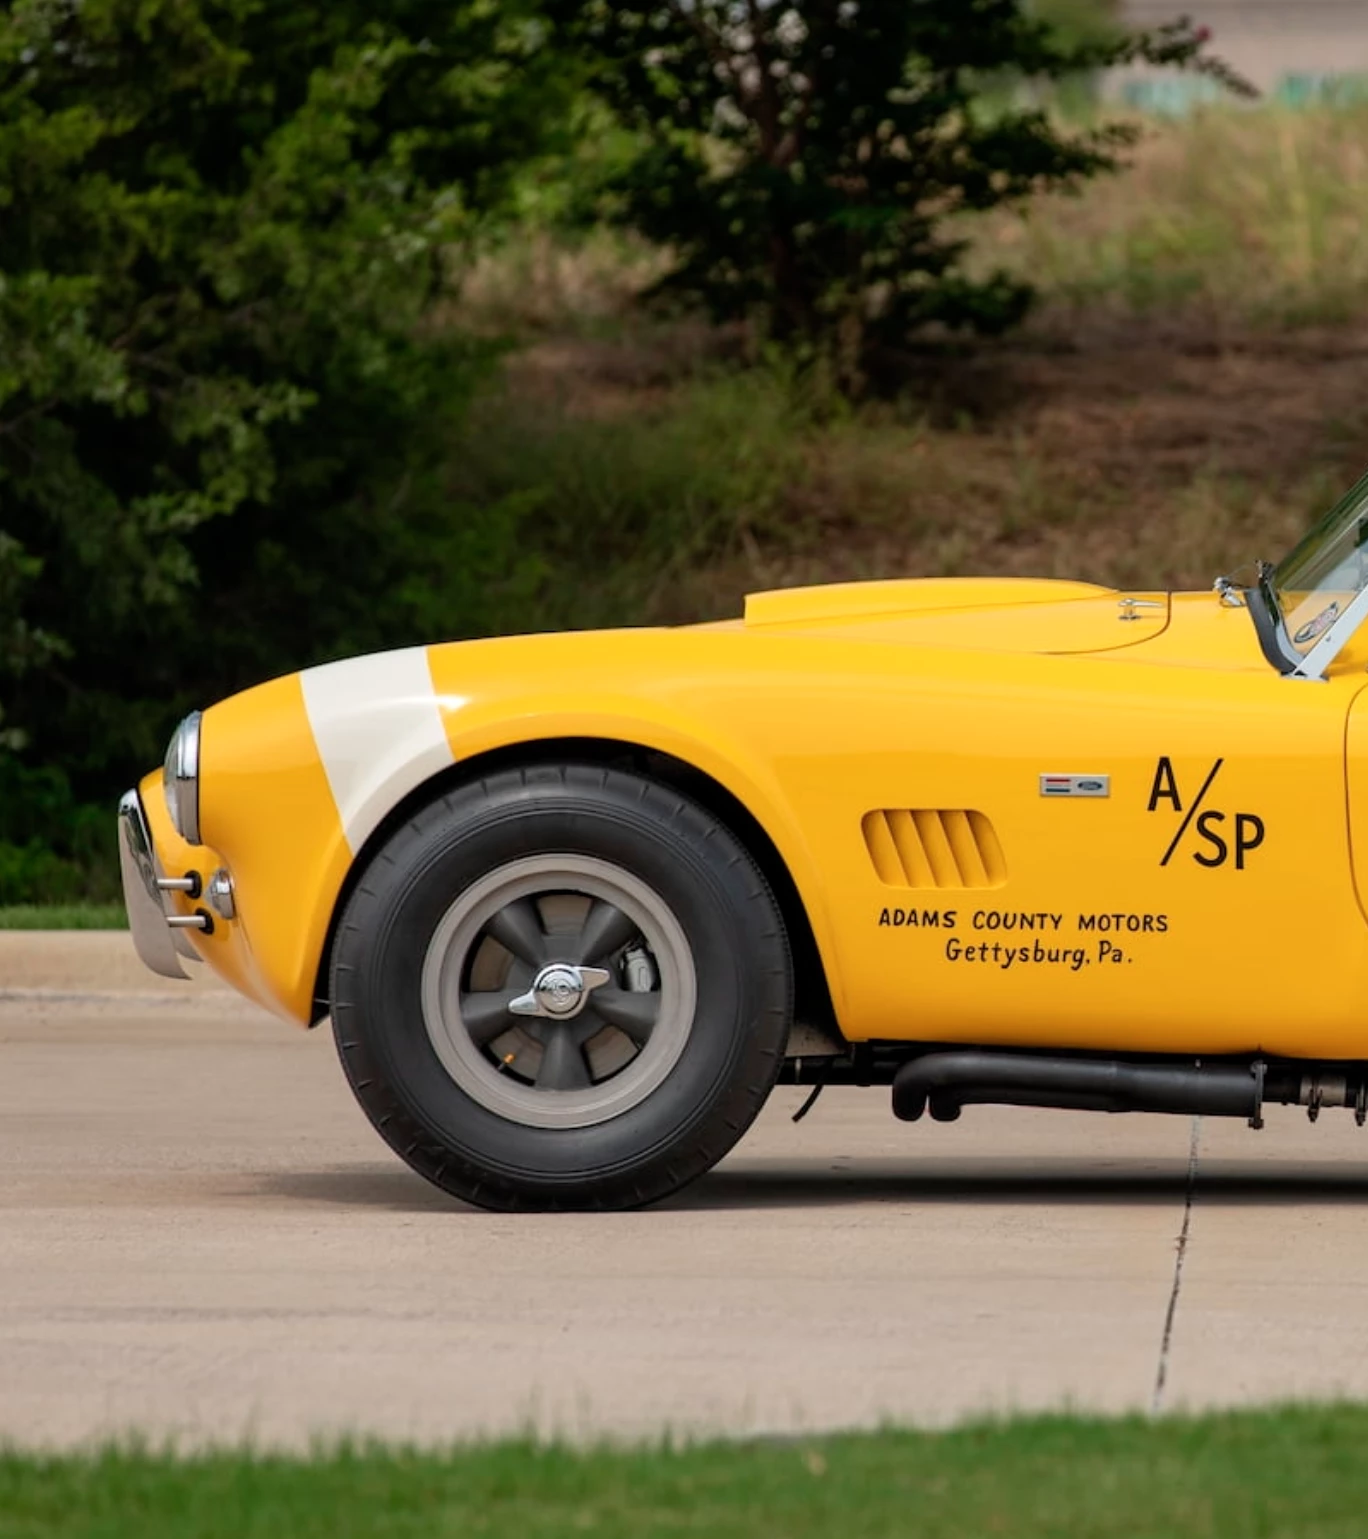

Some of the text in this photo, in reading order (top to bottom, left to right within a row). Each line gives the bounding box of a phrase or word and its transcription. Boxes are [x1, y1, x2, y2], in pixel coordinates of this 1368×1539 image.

[878, 907, 1169, 932] ADAMS COUNTY MOTORS
[945, 937, 1132, 970] Gettysburg, Pa.
